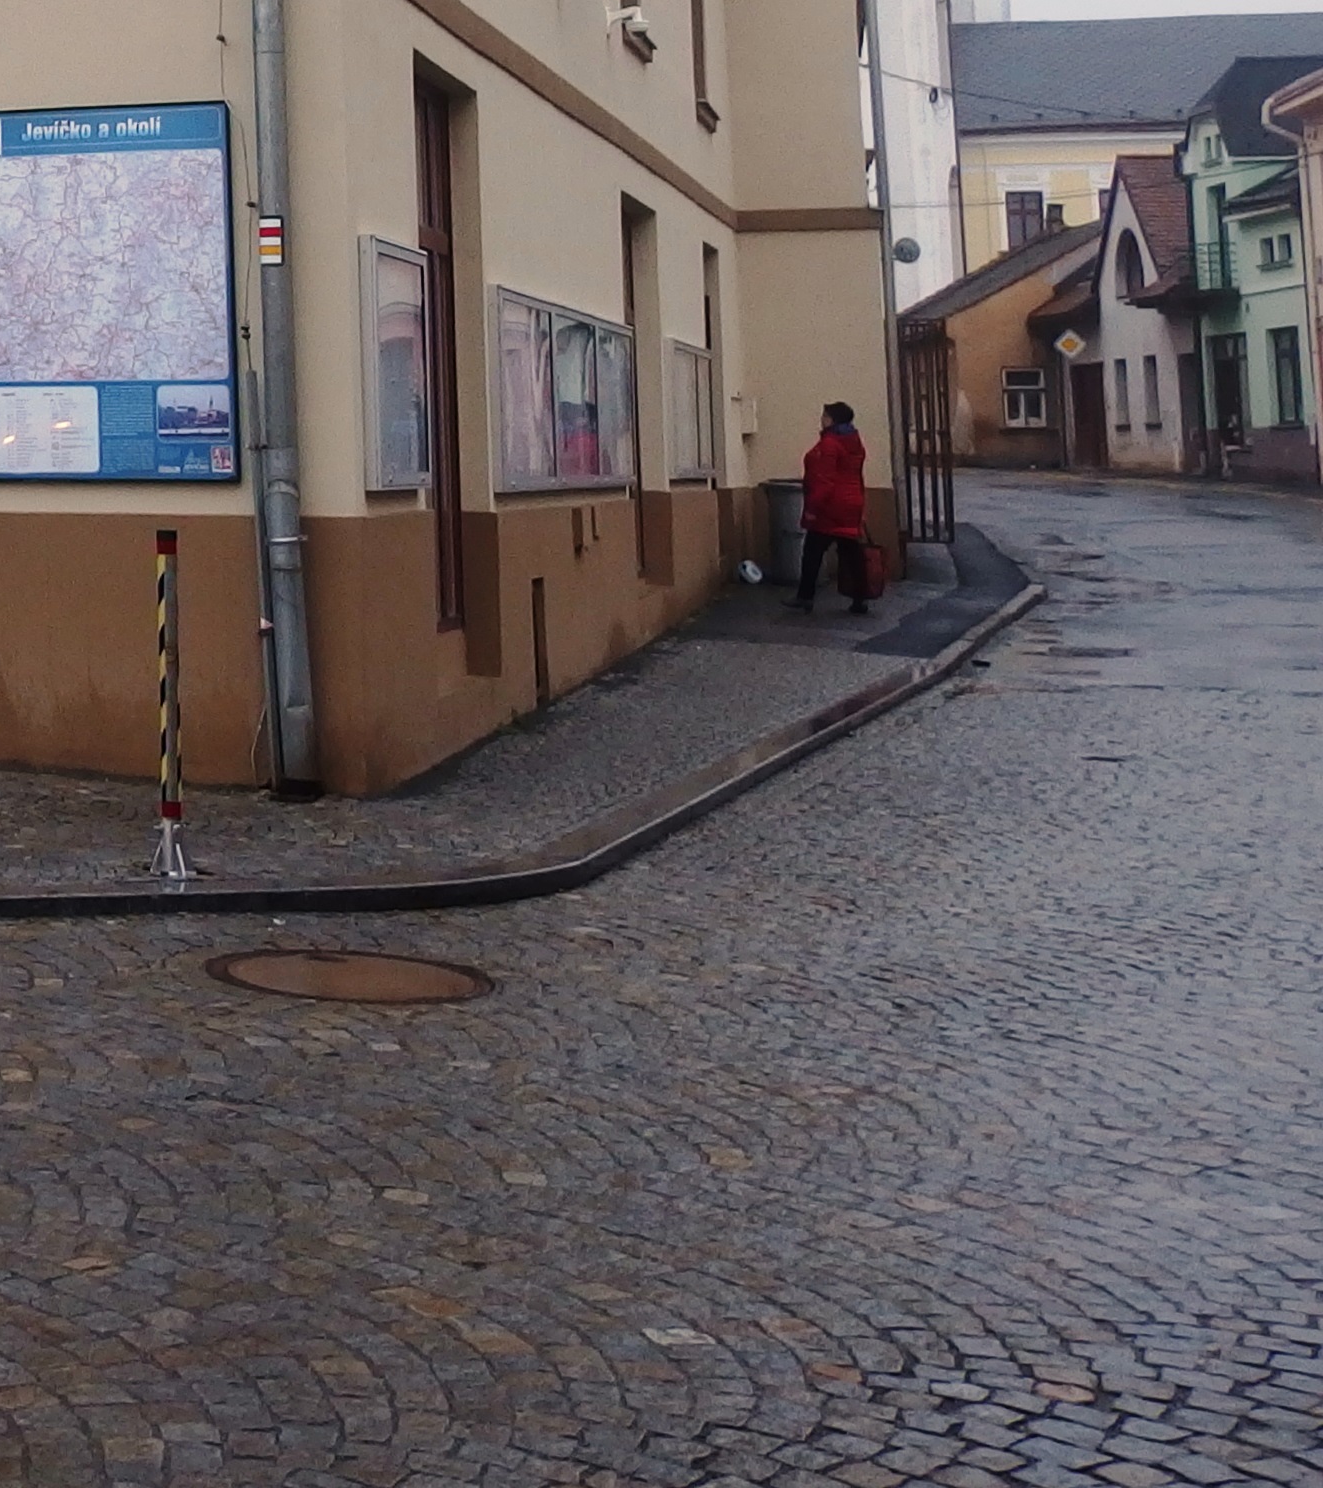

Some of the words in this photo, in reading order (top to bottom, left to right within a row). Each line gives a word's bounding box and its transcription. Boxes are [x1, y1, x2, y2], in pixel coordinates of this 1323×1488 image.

[21, 119, 91, 141] Jevíčko
[98, 122, 109, 138] a
[116, 116, 161, 137] okolí
